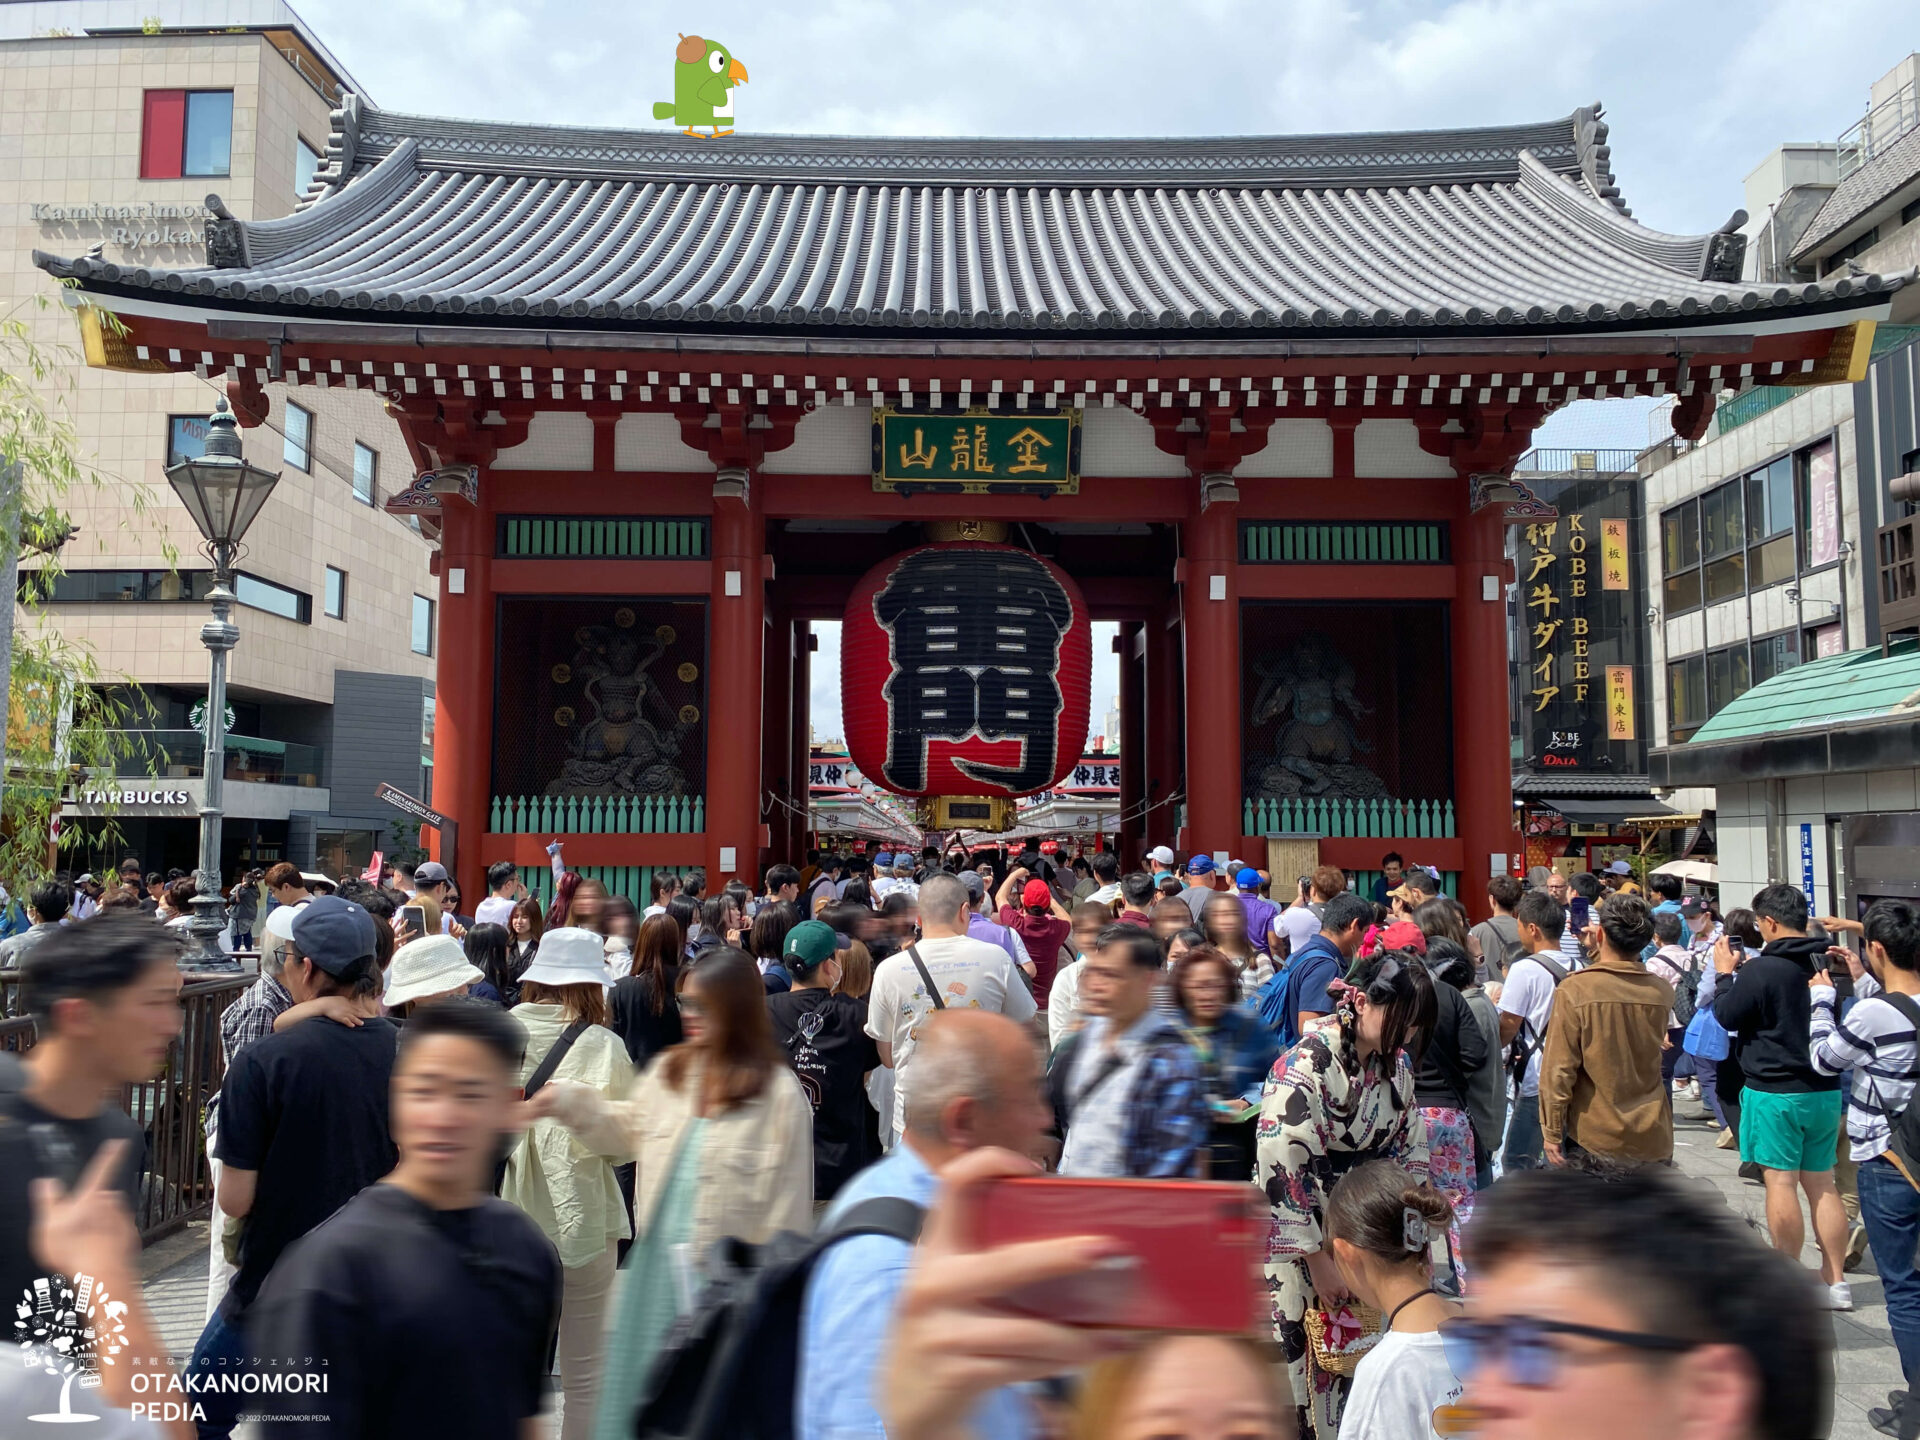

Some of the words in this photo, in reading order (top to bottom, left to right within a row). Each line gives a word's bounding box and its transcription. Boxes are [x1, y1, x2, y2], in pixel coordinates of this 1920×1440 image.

[31, 202, 213, 220] Kaminarimon
[1568, 514, 1587, 597] KOBE
[1607, 524, 1622, 583] 鉄板焼
[872, 548, 1074, 793] 雷門
[1570, 617, 1589, 701] BEEF
[1612, 670, 1627, 733] 雷門東店
[79, 790, 188, 804] TARBUCKS
[386, 789, 427, 814] KAMINARIMON
[425, 811, 442, 823] GATE
